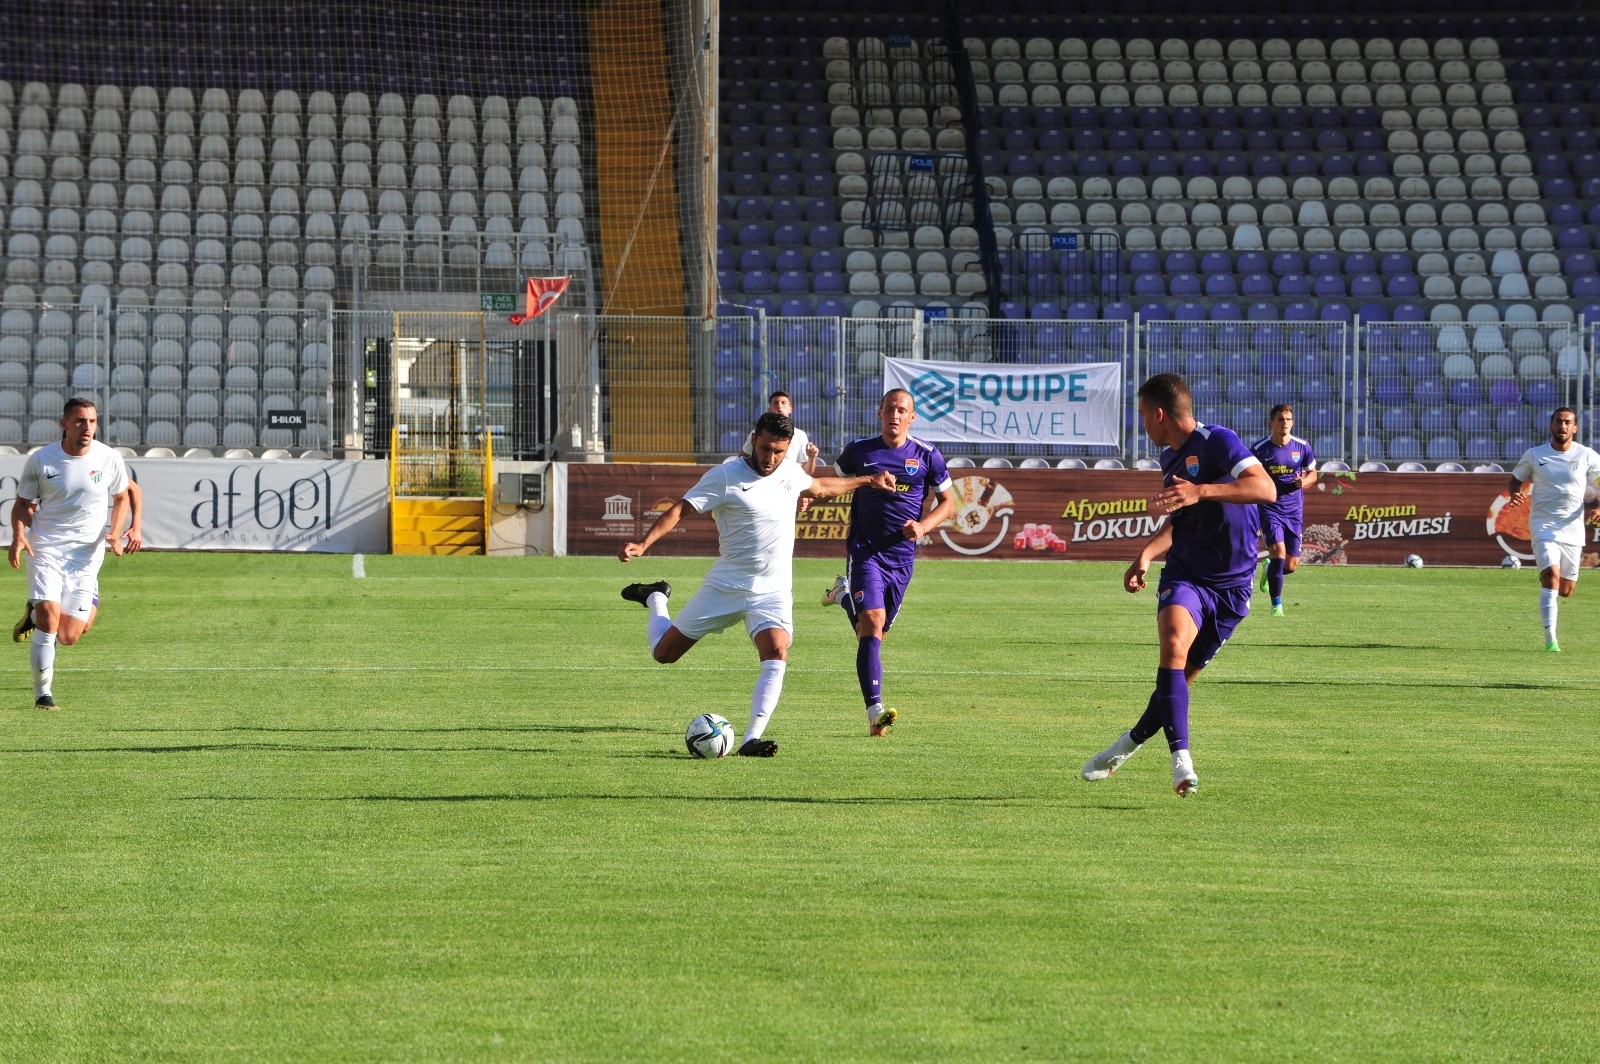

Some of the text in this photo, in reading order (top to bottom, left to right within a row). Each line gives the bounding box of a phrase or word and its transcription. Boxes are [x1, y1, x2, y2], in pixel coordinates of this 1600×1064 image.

[958, 373, 1088, 406] EQUIPE
[271, 415, 302, 424] B-BLOK
[957, 410, 1086, 436] TRAVEL
[190, 464, 331, 530] afbel
[1353, 512, 1452, 540] BÜKMESİ
